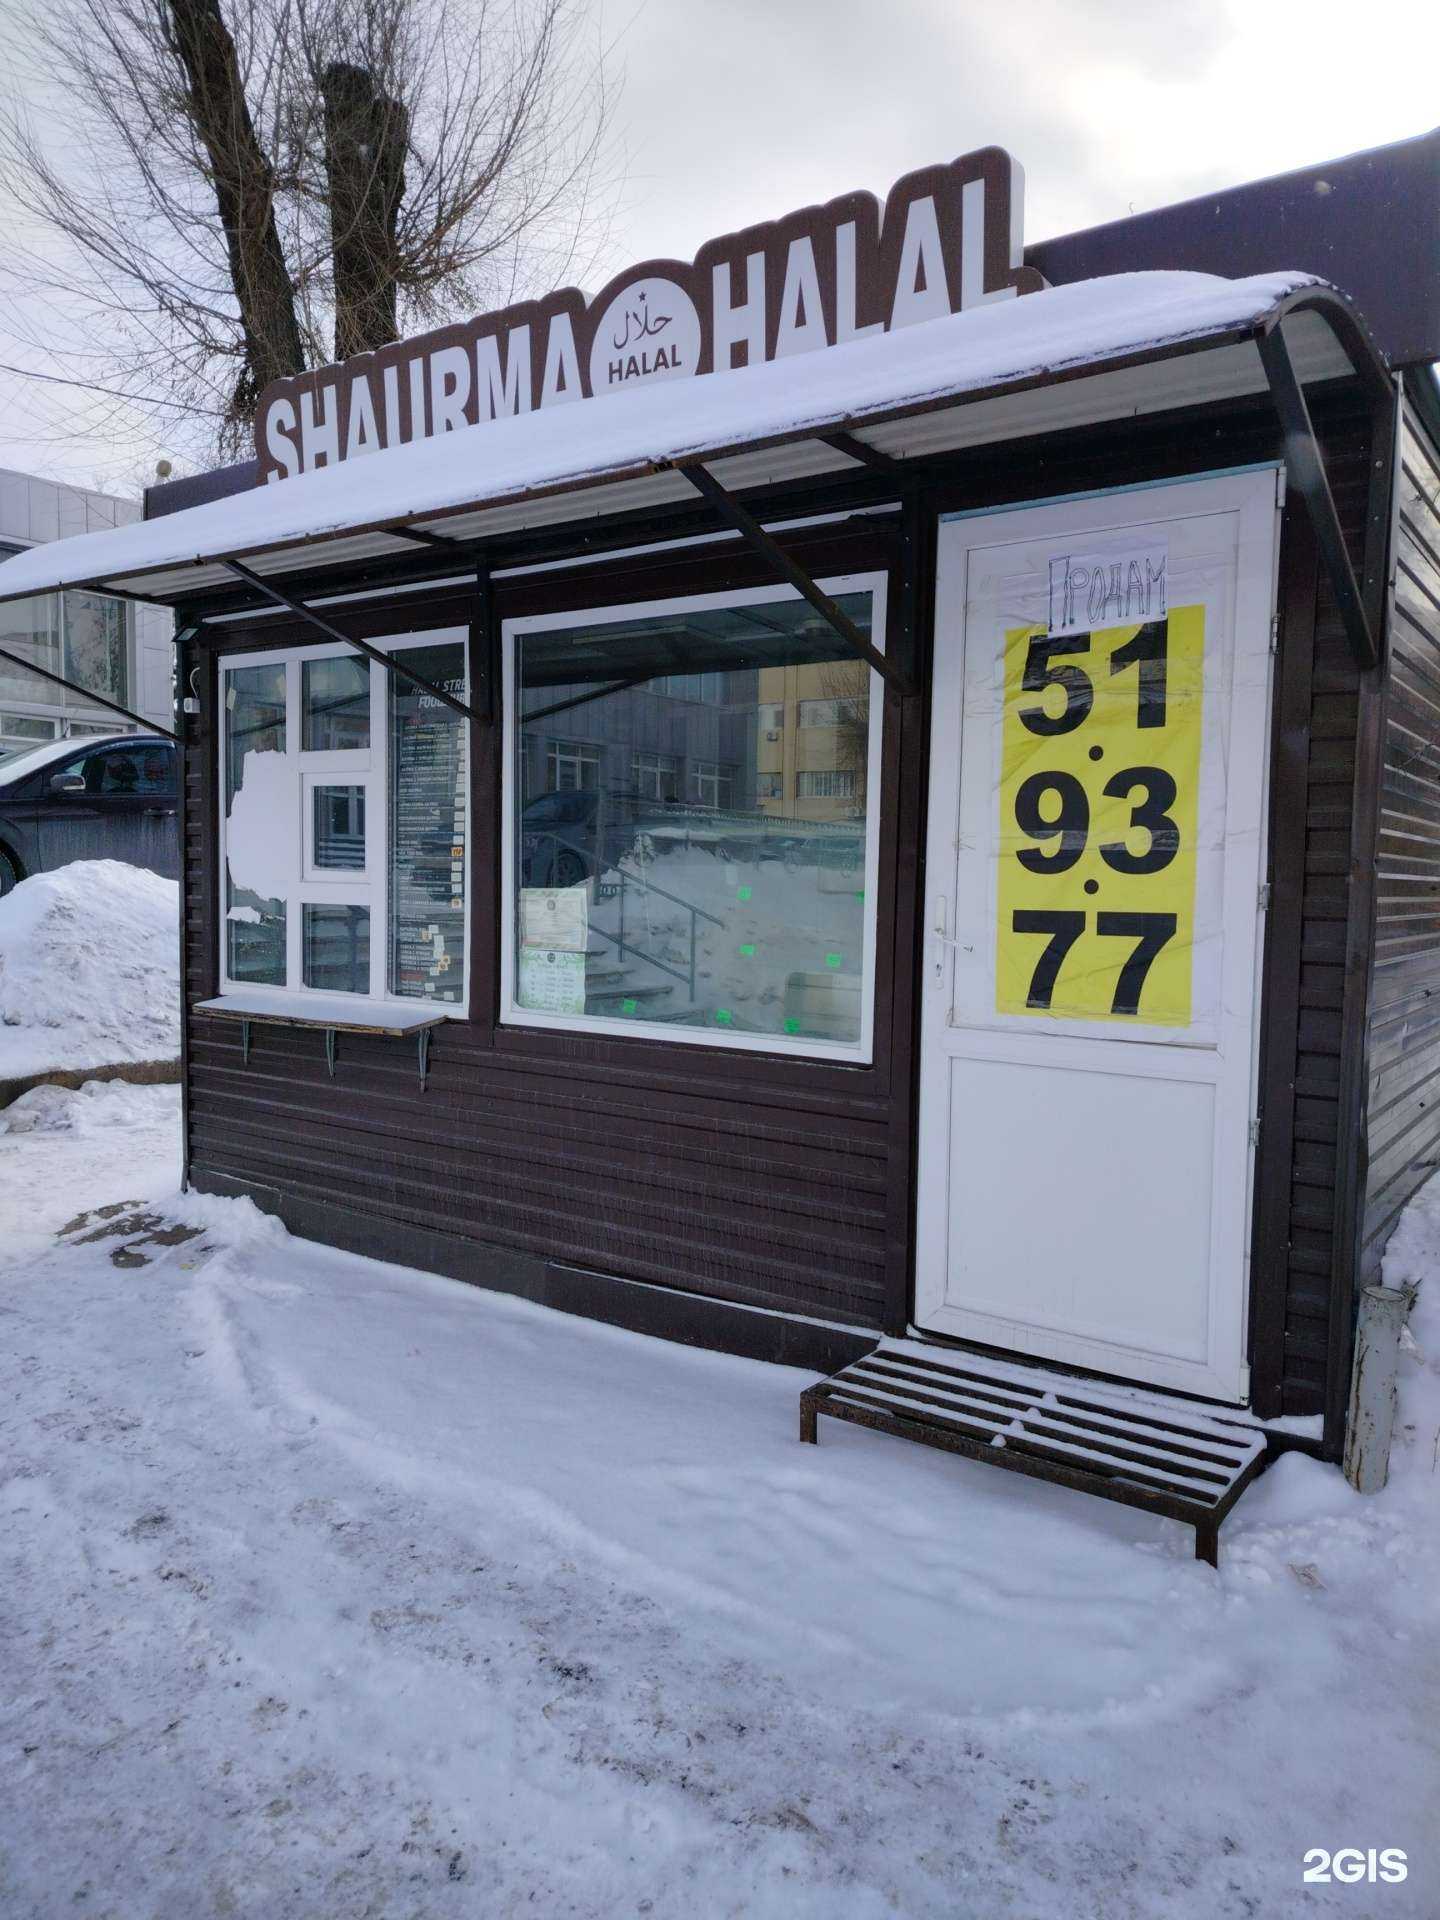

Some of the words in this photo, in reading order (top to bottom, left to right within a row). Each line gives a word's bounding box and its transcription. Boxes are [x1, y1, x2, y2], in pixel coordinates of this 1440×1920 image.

[266, 311, 583, 485] SHAURMA
[712, 178, 1018, 372] HALAL
[608, 344, 682, 384] HALAL
[613, 304, 673, 350] حلال
[1017, 618, 1168, 737] 51
[1014, 765, 1181, 876] 93
[1012, 909, 1178, 1016] 77
